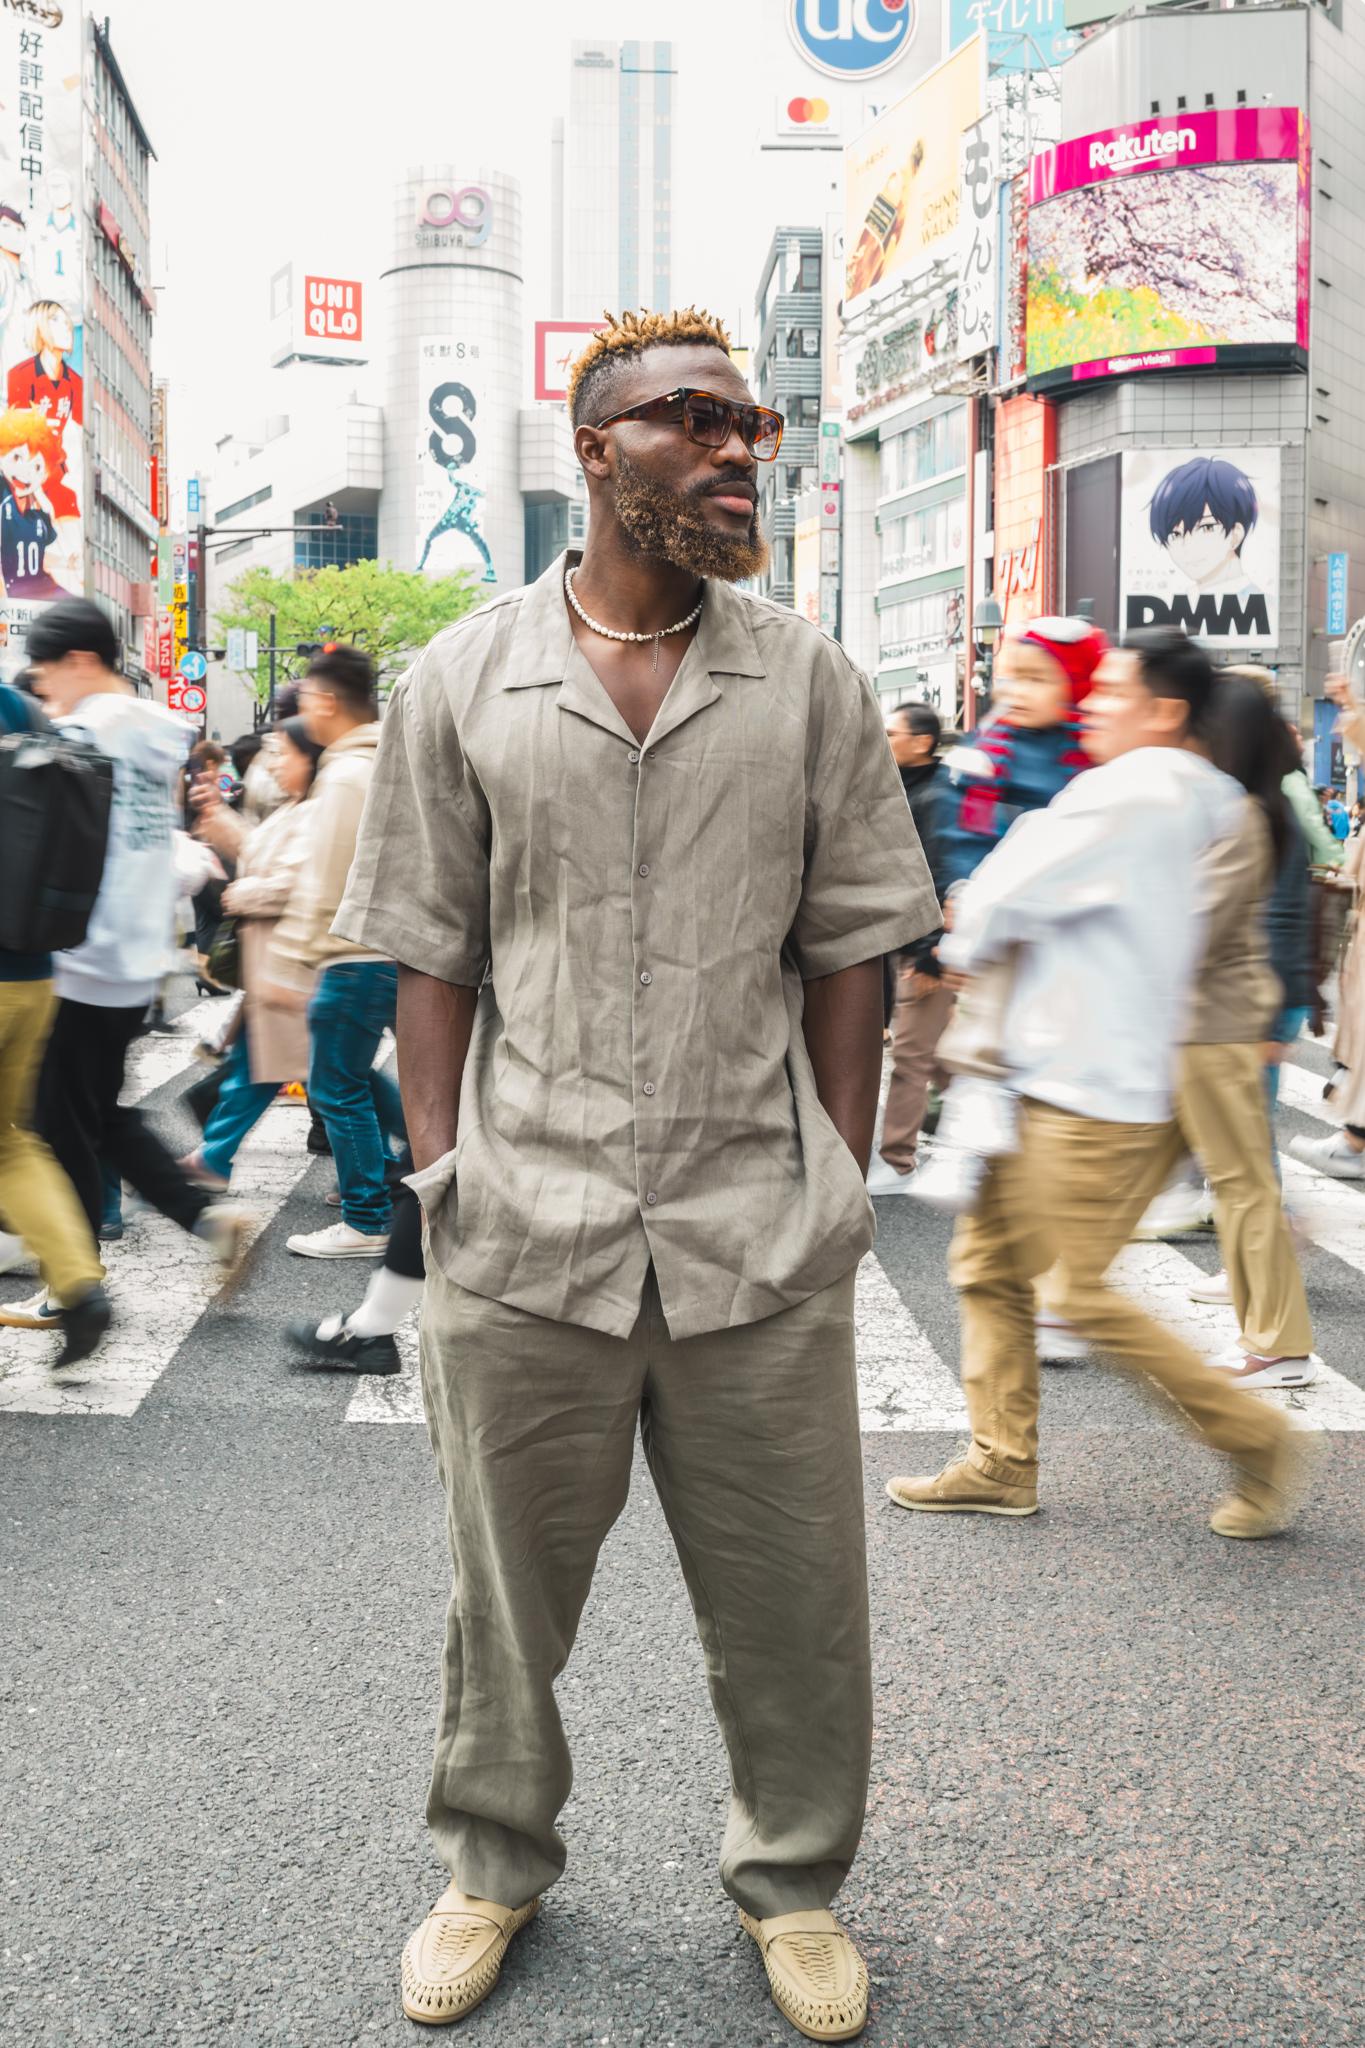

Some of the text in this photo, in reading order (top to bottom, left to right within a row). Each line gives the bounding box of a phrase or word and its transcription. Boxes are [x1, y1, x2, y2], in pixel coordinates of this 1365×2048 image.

[19, 29, 44, 209] 好評配信中！
[1089, 128, 1197, 169] Rakuten
[415, 232, 463, 248] SHIBUYA
[310, 282, 353, 308] UNI
[309, 309, 358, 336] QLO
[1108, 353, 1170, 371] Rakuten Vision
[16, 541, 39, 577] 10
[1127, 594, 1271, 635] DMM
